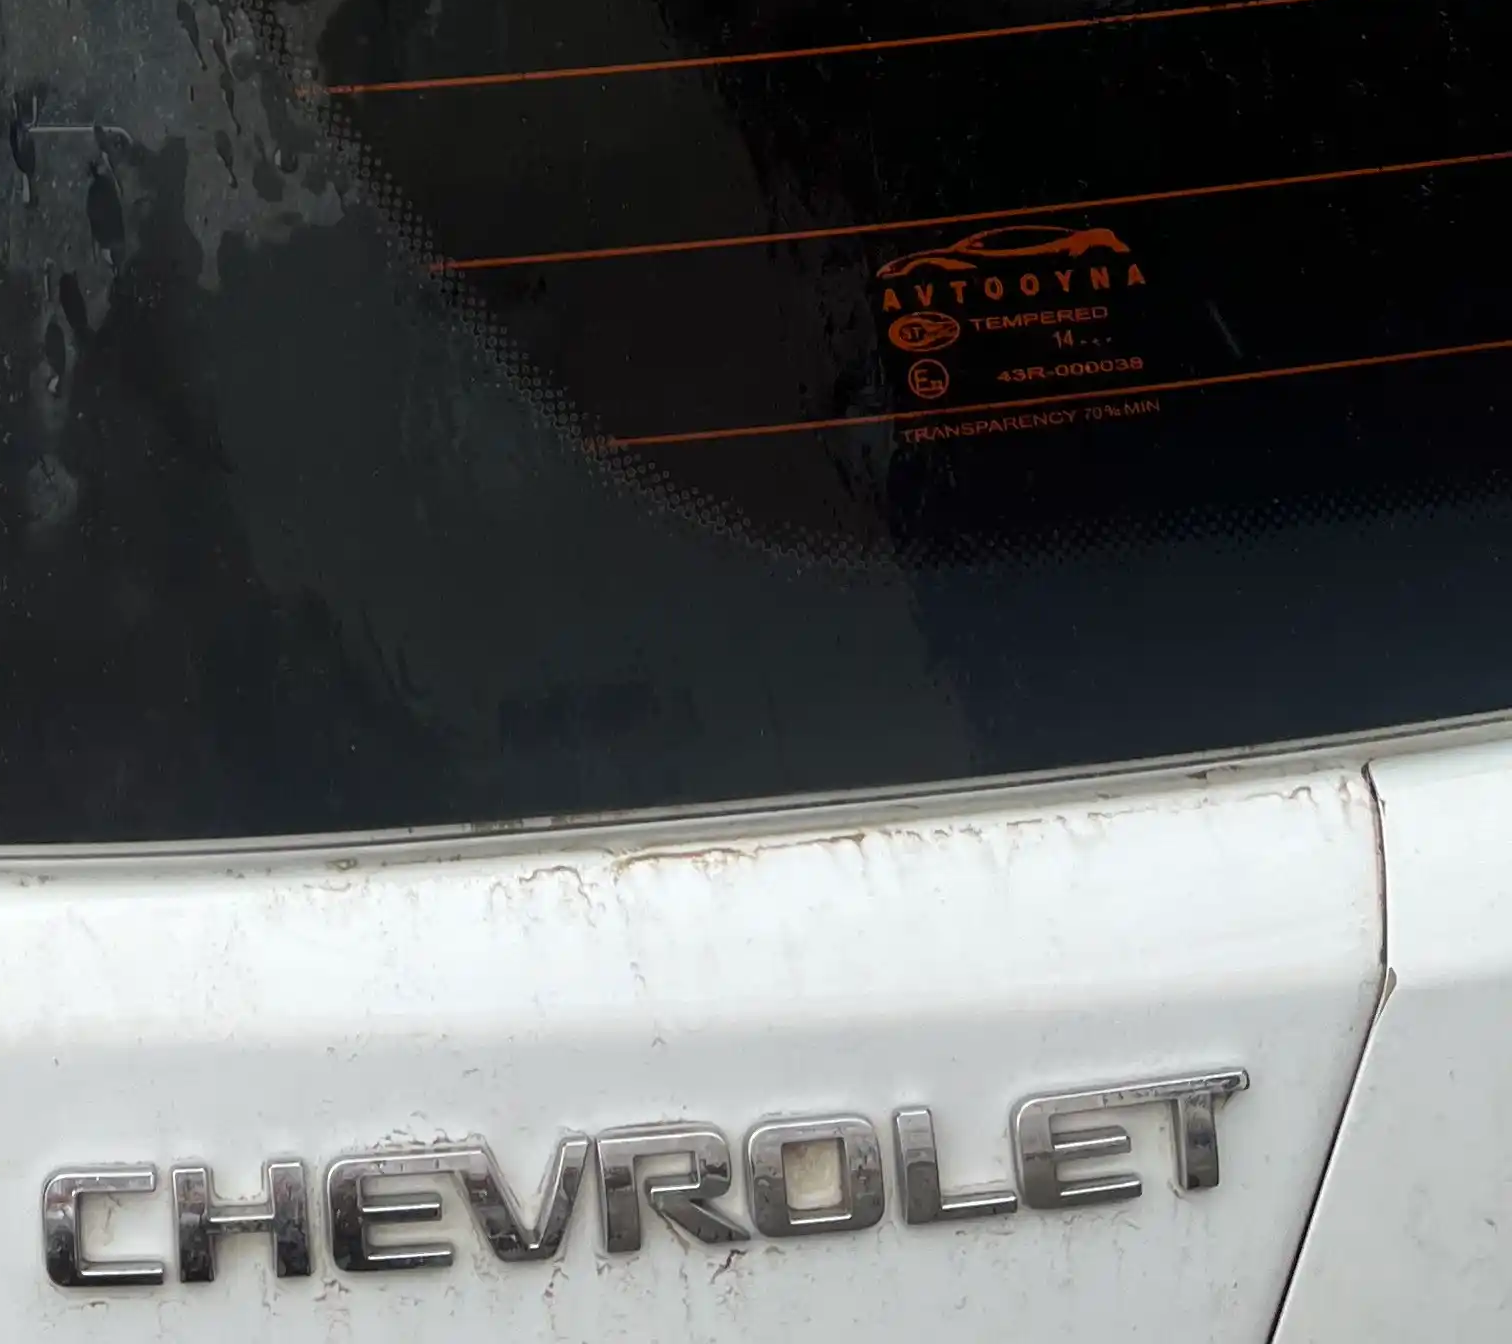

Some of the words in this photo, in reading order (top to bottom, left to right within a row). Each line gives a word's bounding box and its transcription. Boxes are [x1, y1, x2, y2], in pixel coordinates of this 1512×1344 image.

[882, 263, 1146, 312] AVTOOYNA
[969, 305, 1109, 332] TEMPERED
[902, 409, 1077, 444] TRANSPARENCY
[1123, 398, 1161, 416] MIN
[43, 1067, 1251, 1290] CHEVROLET
